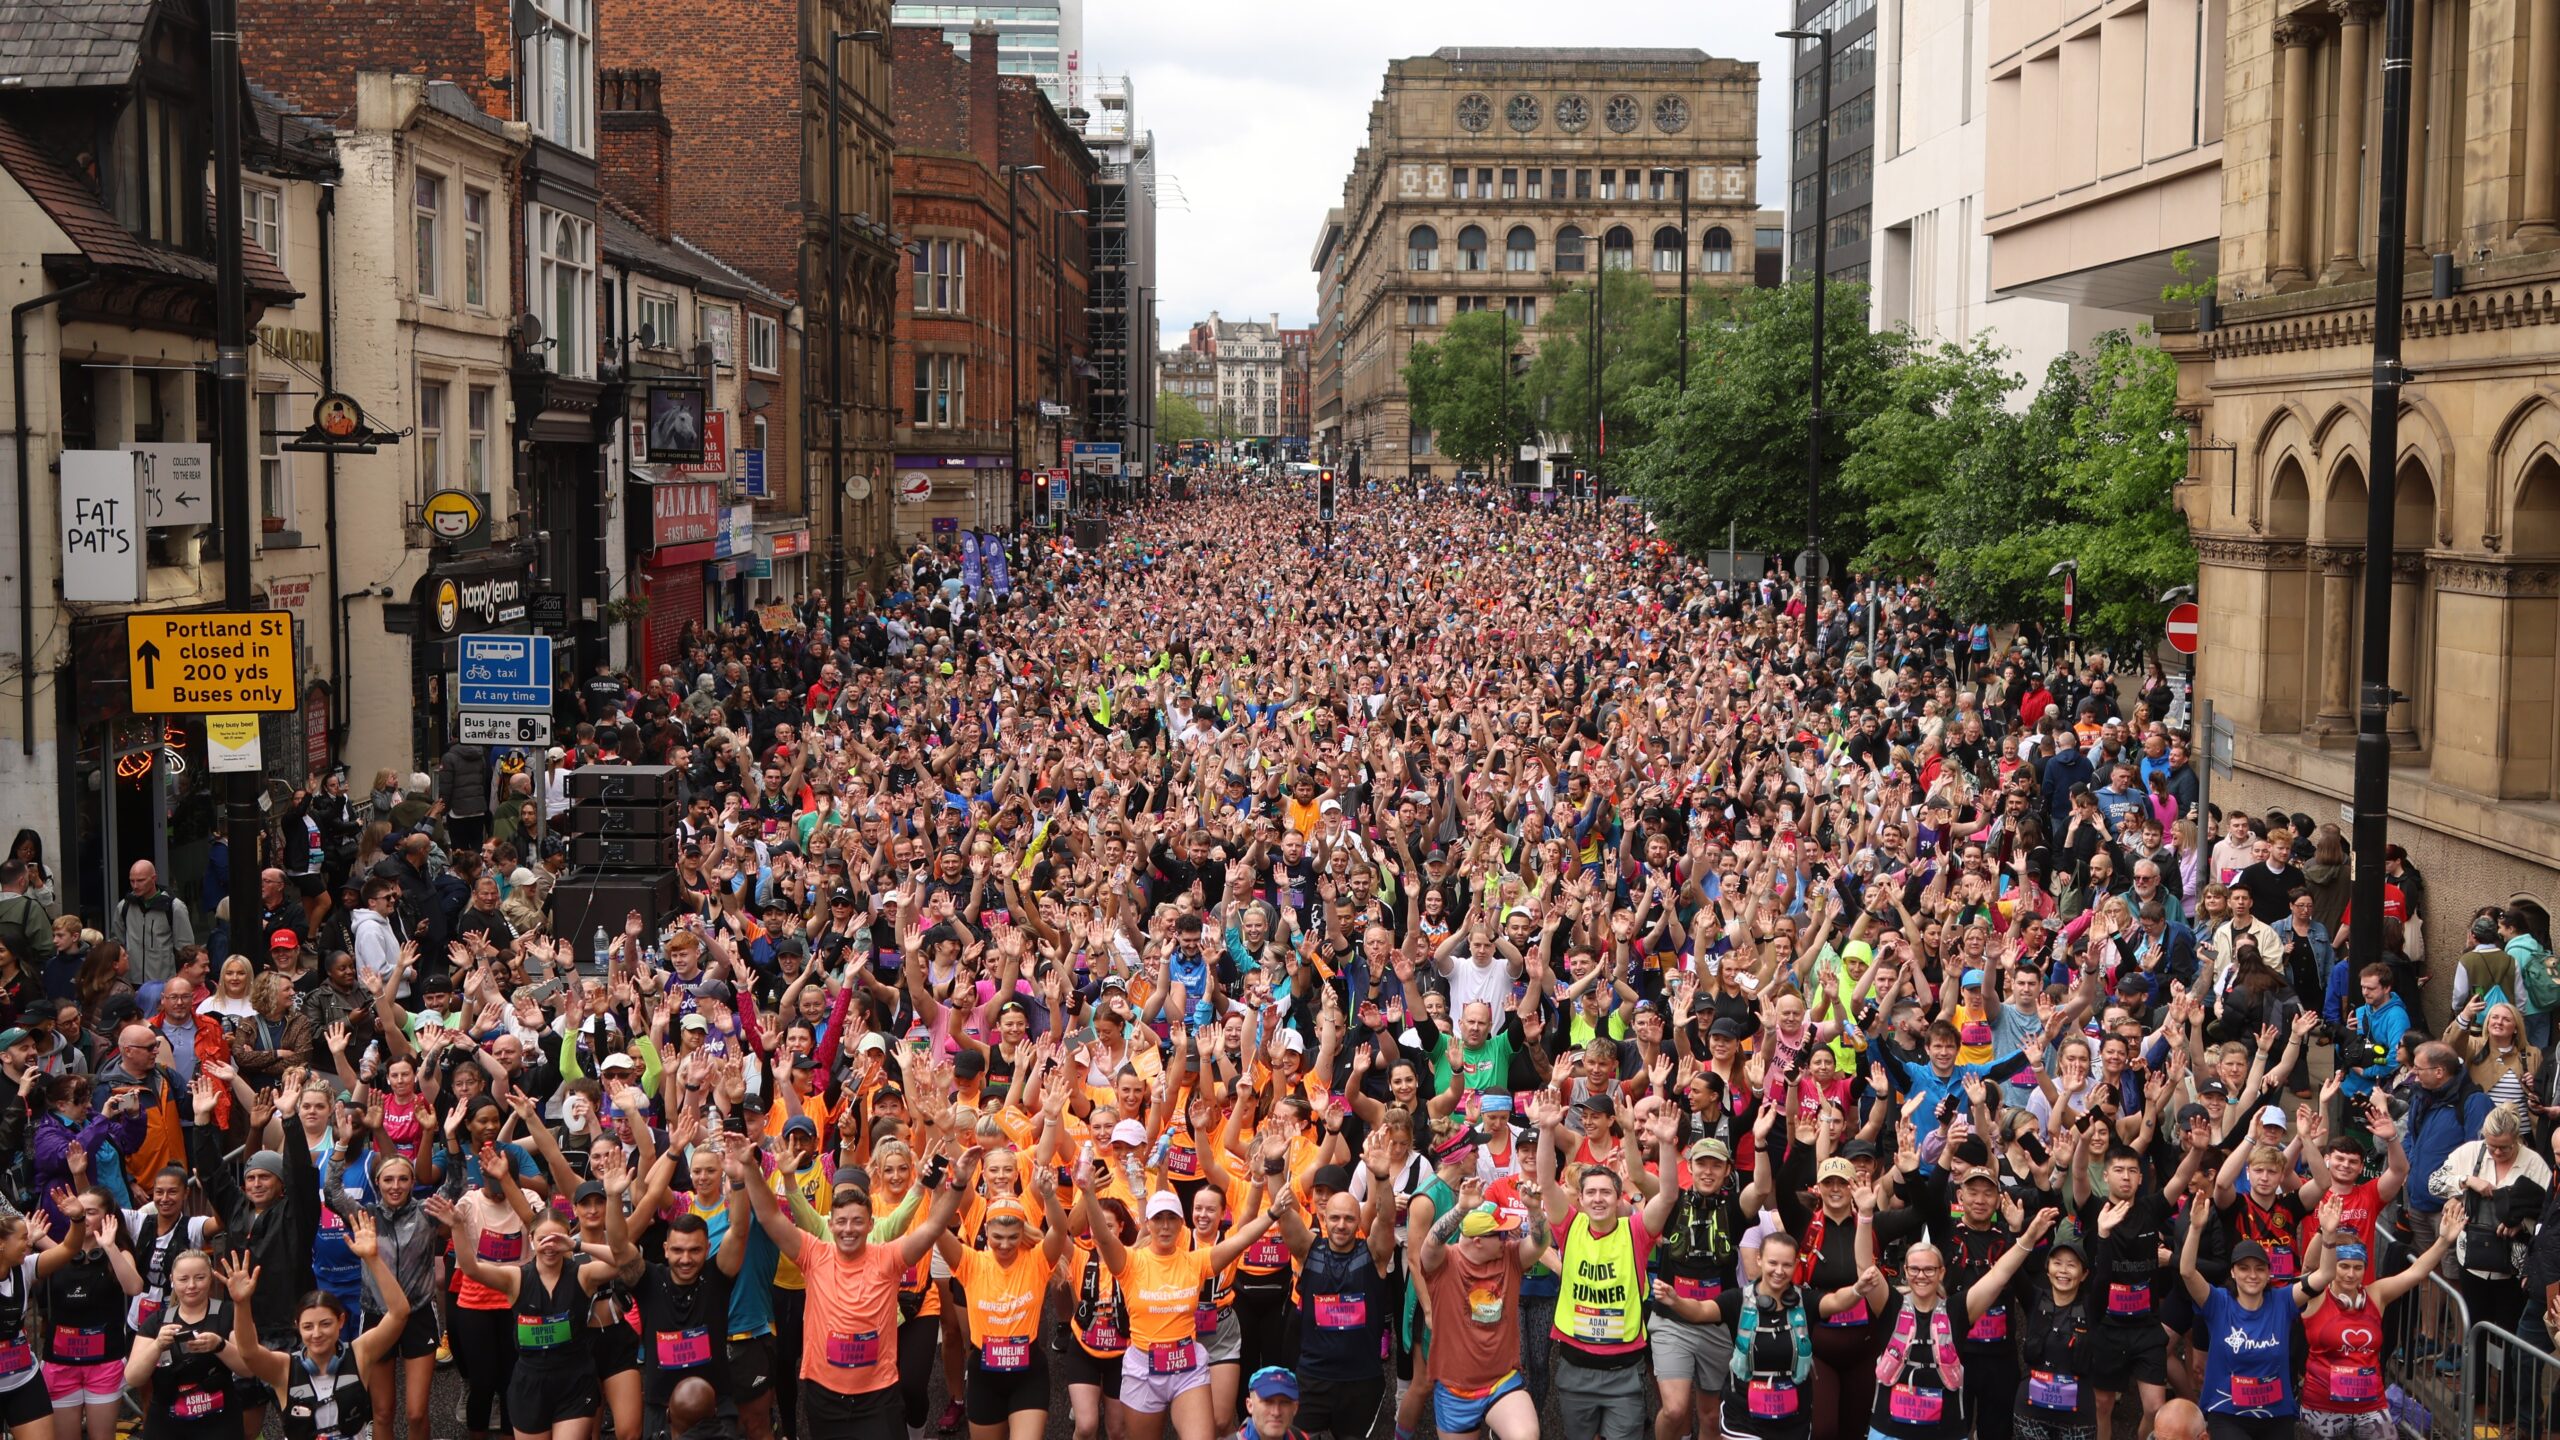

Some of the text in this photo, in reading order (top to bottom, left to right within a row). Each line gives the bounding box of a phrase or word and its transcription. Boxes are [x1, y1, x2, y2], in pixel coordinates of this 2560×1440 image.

[172, 457, 200, 466] COLLECTION
[680, 462, 722, 471] CHICKEN
[173, 472, 201, 480] TO THE REAR
[76, 498, 119, 526] FAT
[667, 524, 704, 541] FAST FOOD
[68, 527, 130, 554] PAT'S
[166, 620, 283, 638] Portland St
[180, 642, 269, 659] closed in
[183, 663, 268, 683] 200 yds
[497, 668, 517, 678] taxi
[173, 685, 282, 704] Buses only
[474, 690, 536, 702] At any time
[464, 717, 511, 728] Bus lane
[464, 730, 510, 739] cameras
[1824, 1161, 1846, 1171] GAP
[1508, 1197, 1525, 1208] Tea
[1262, 1245, 1278, 1255] KATE
[1578, 1260, 1616, 1282] GUIDE
[1573, 1282, 1626, 1304] RUNNER
[1589, 1318, 1609, 1327] ADAM
[531, 1325, 555, 1336] SOPHIE
[1097, 1328, 1115, 1338] EMILY
[2244, 1332, 2279, 1350] mind
[992, 1345, 1025, 1356] MADELINE
[1168, 1349, 1185, 1360] ELLIE
[1166, 1359, 1187, 1371] 17423
